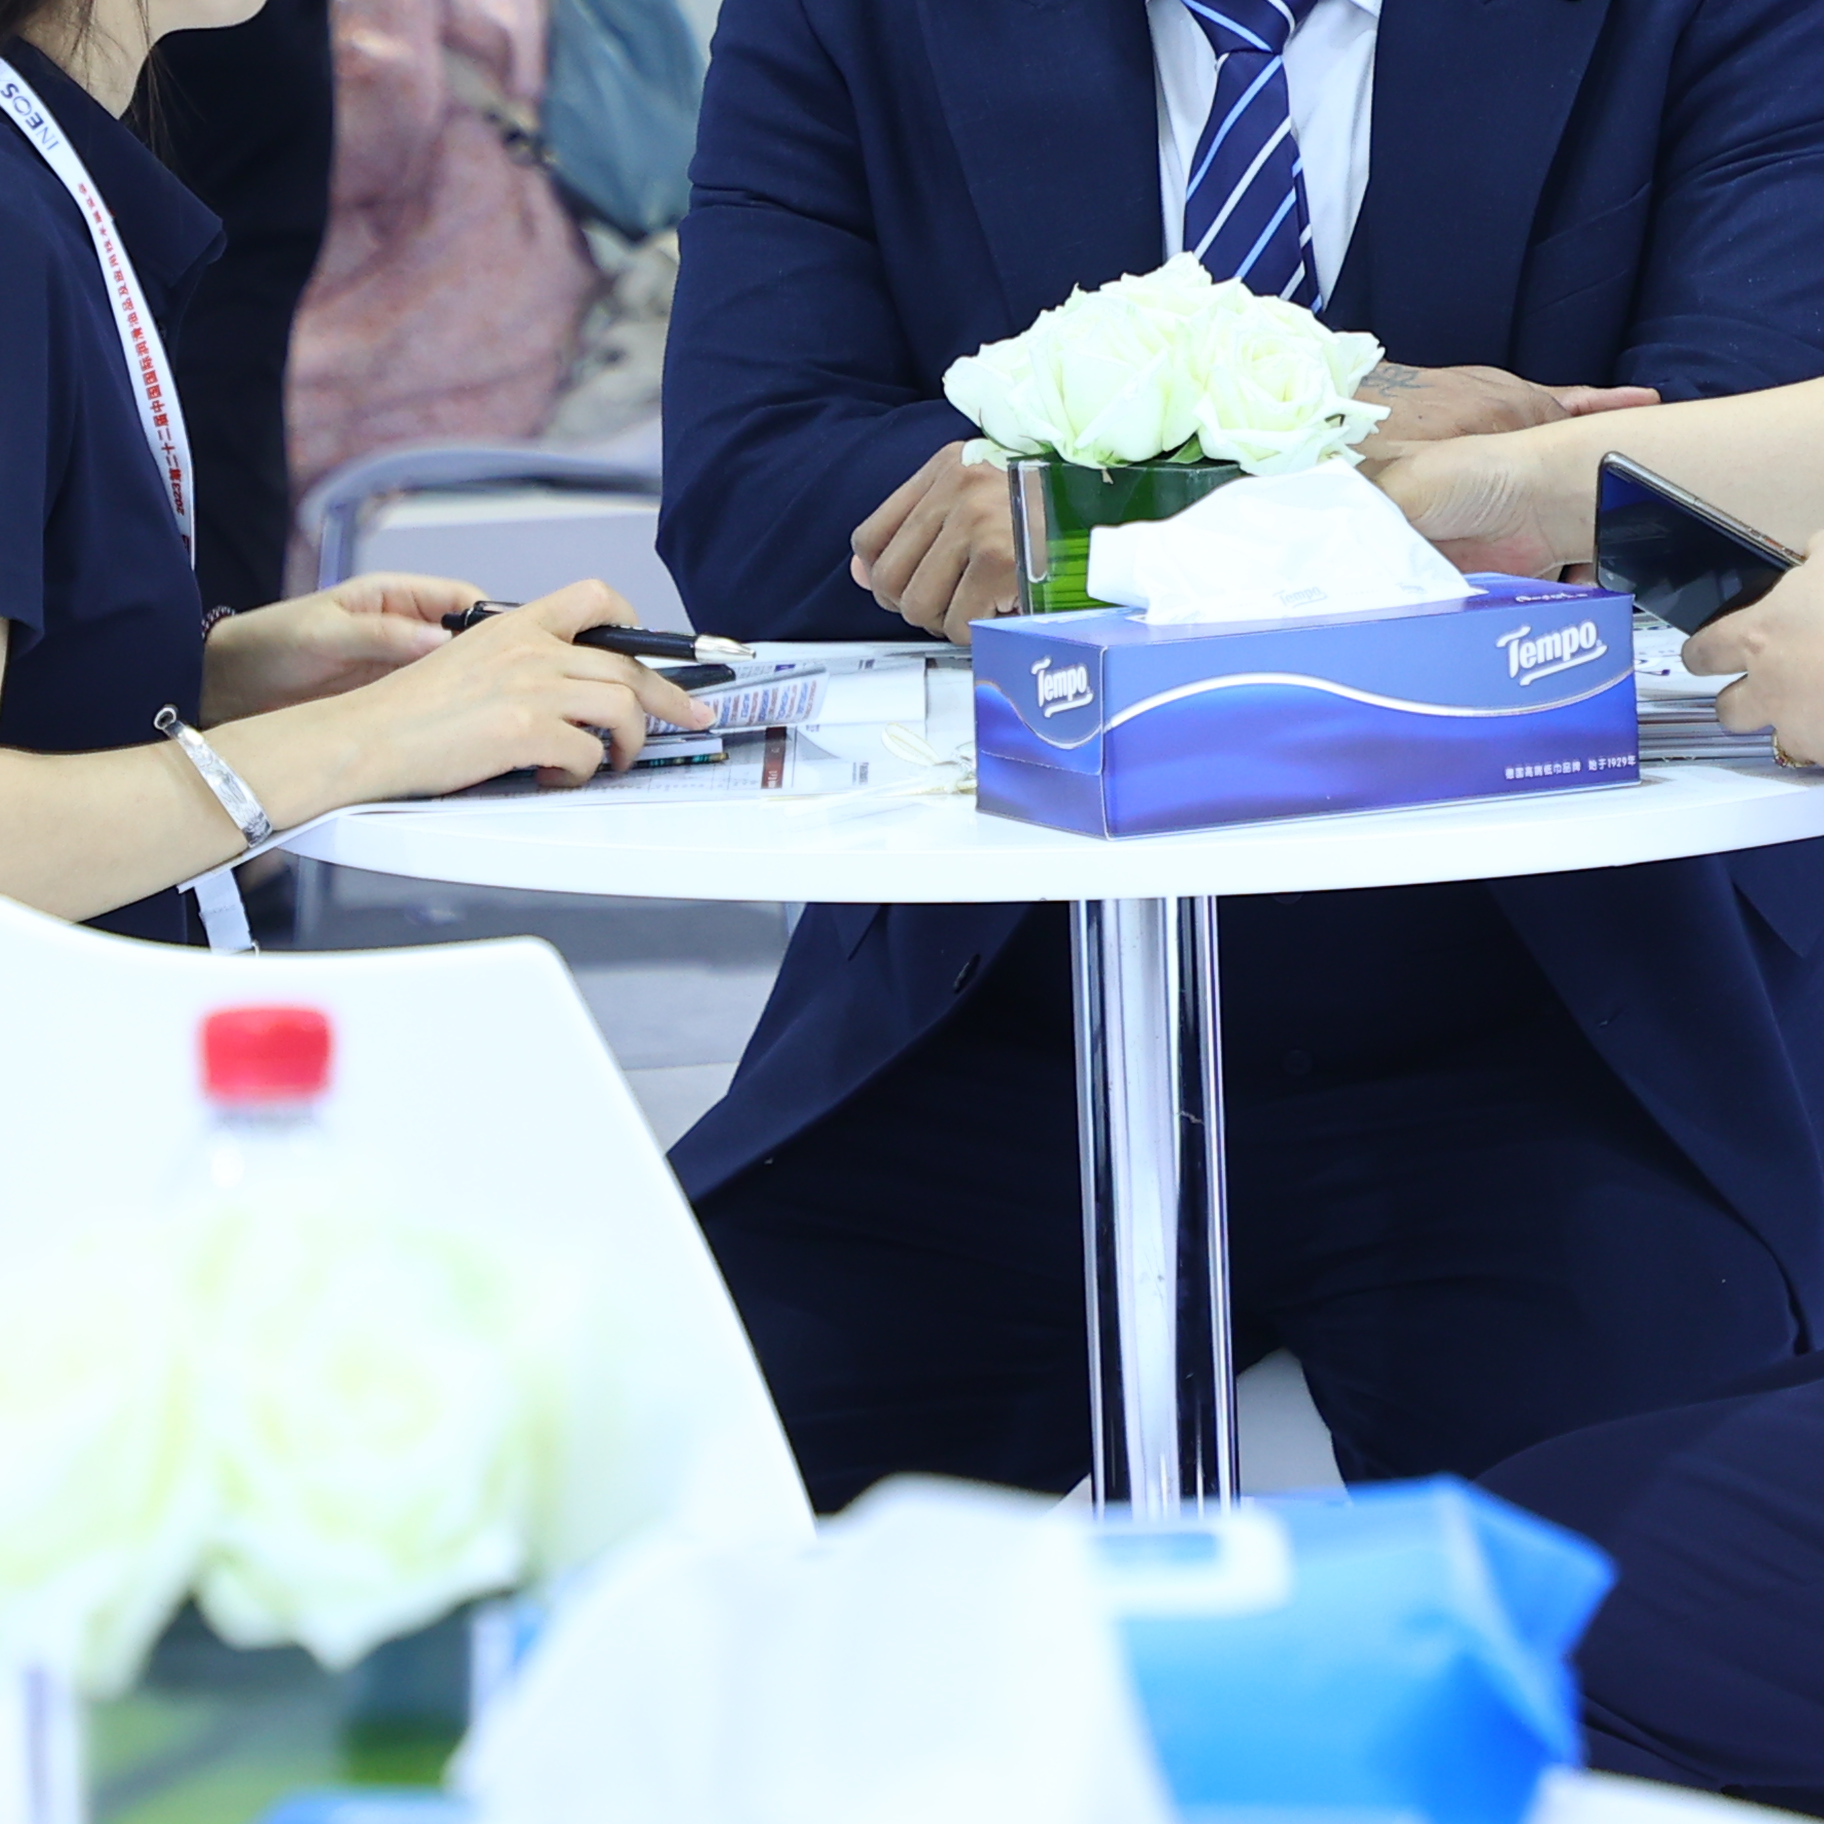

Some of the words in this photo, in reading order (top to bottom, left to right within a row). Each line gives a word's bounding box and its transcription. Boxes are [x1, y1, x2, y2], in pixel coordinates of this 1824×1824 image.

[0, 81, 60, 152] INEOS
[1495, 621, 1608, 686] Tempo
[1030, 656, 1094, 718] Tempo
